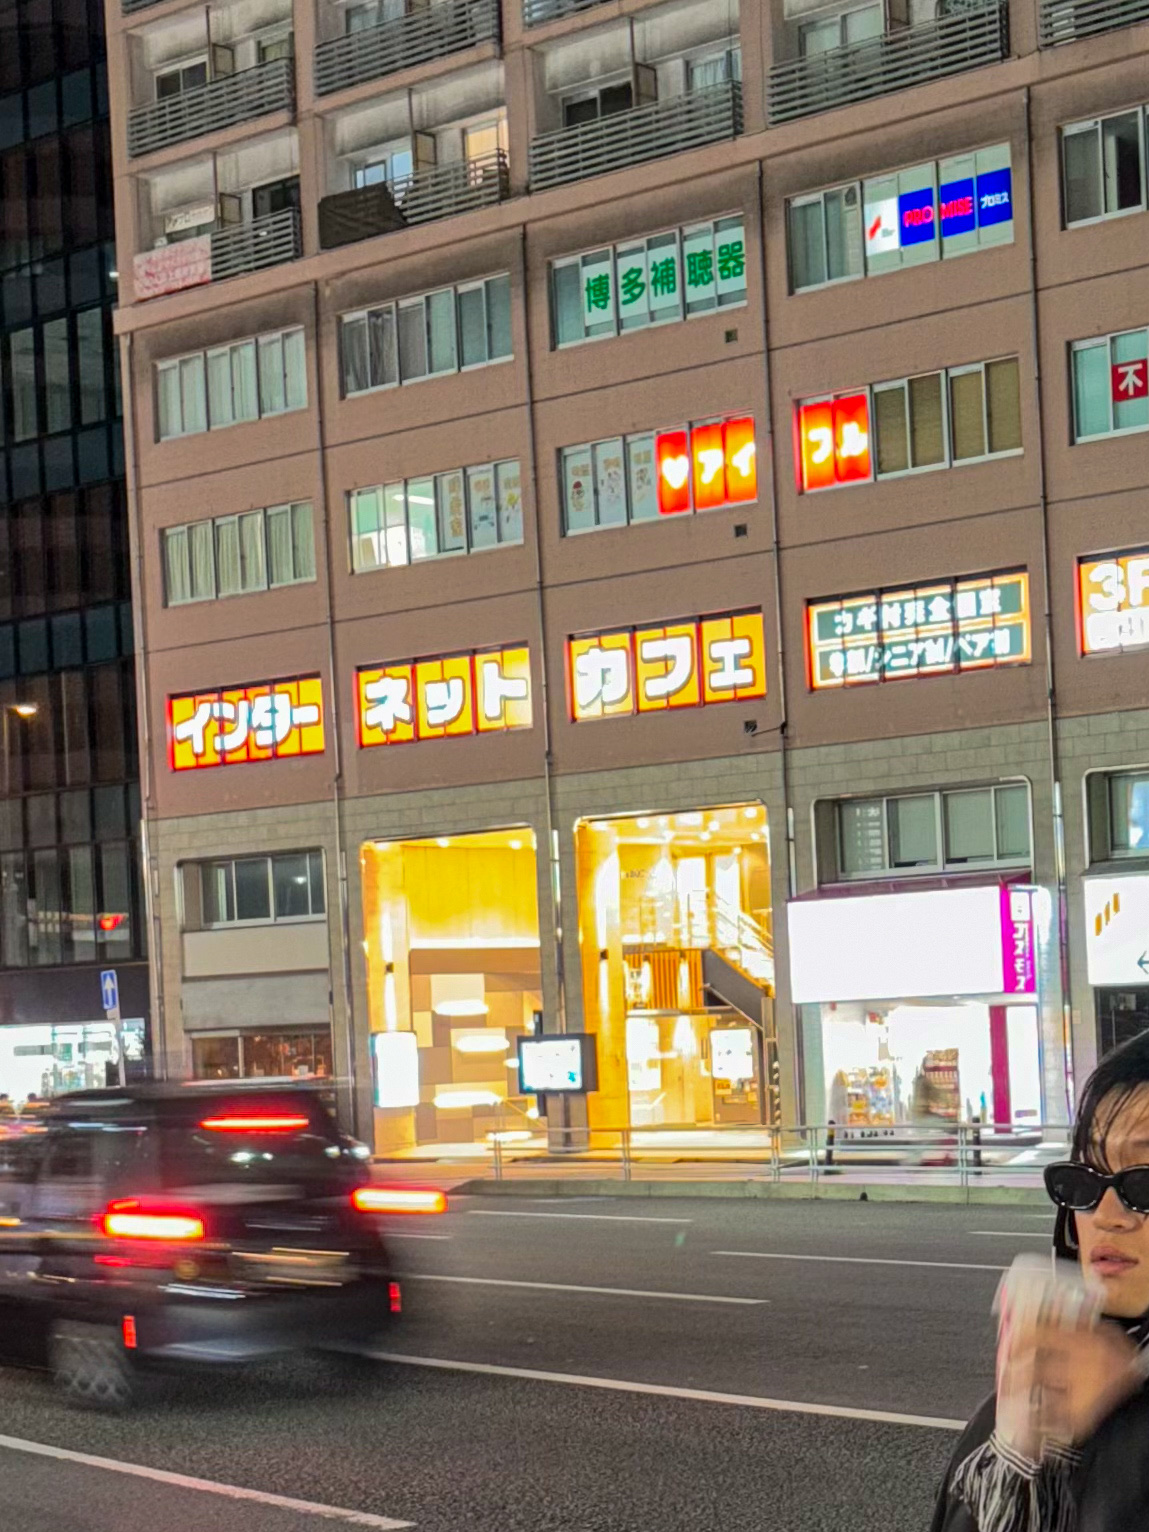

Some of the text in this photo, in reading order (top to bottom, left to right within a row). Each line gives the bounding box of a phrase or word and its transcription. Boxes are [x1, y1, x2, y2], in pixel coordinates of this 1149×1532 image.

[903, 196, 974, 228] PROMISE
[585, 240, 745, 313] 博多補聴器
[174, 634, 756, 756] インター ネット カフェ
